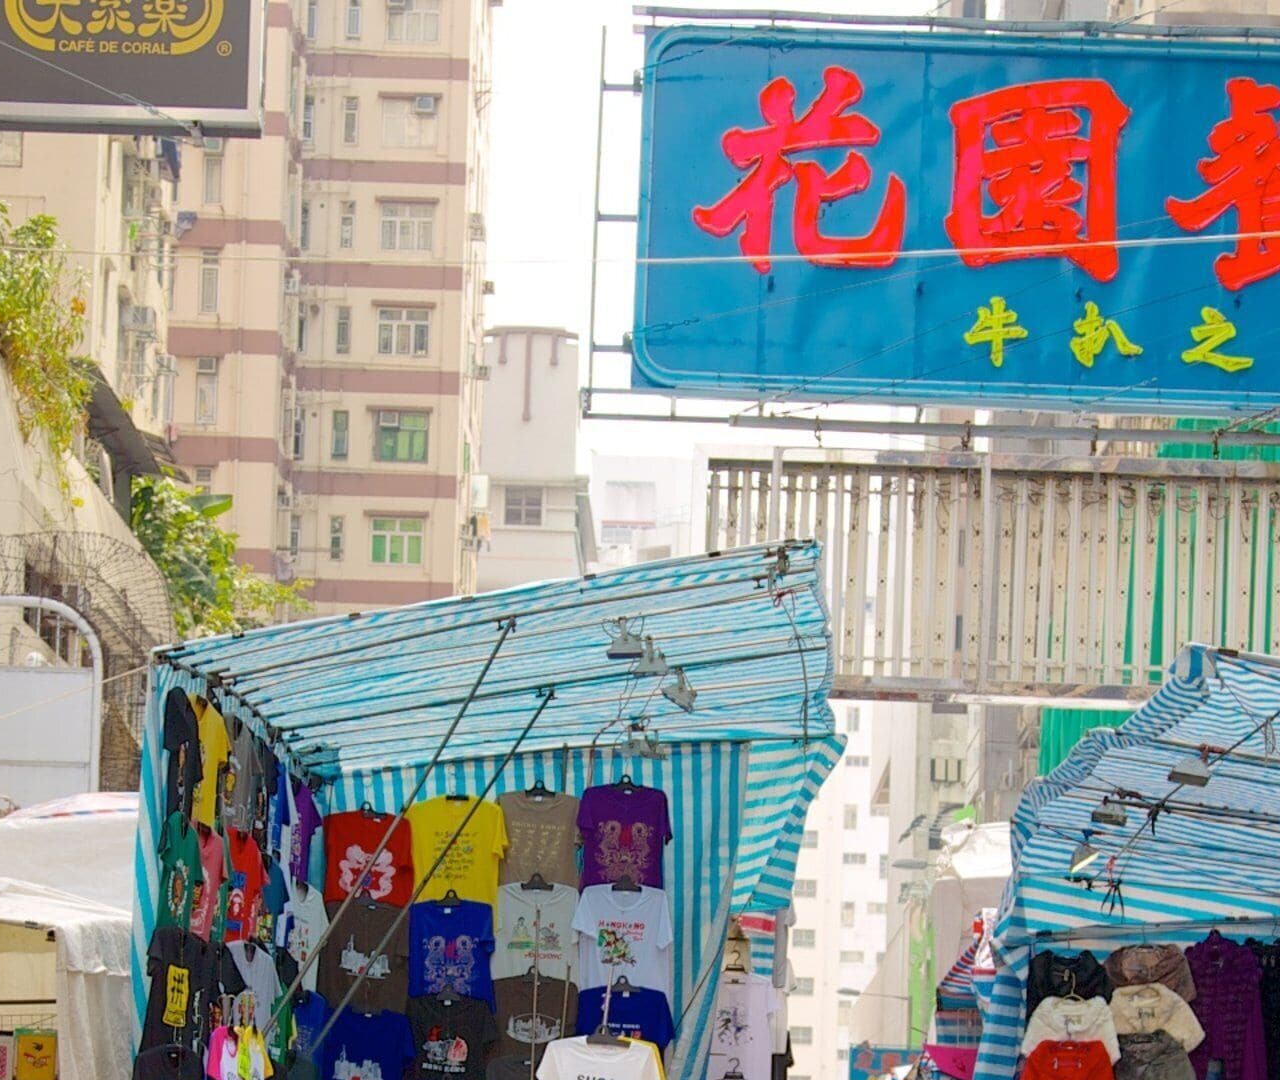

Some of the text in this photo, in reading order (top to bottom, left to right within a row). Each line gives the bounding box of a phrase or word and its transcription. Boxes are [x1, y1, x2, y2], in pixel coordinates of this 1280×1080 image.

[58, 38, 170, 55] CAFÉ DE CORAL
